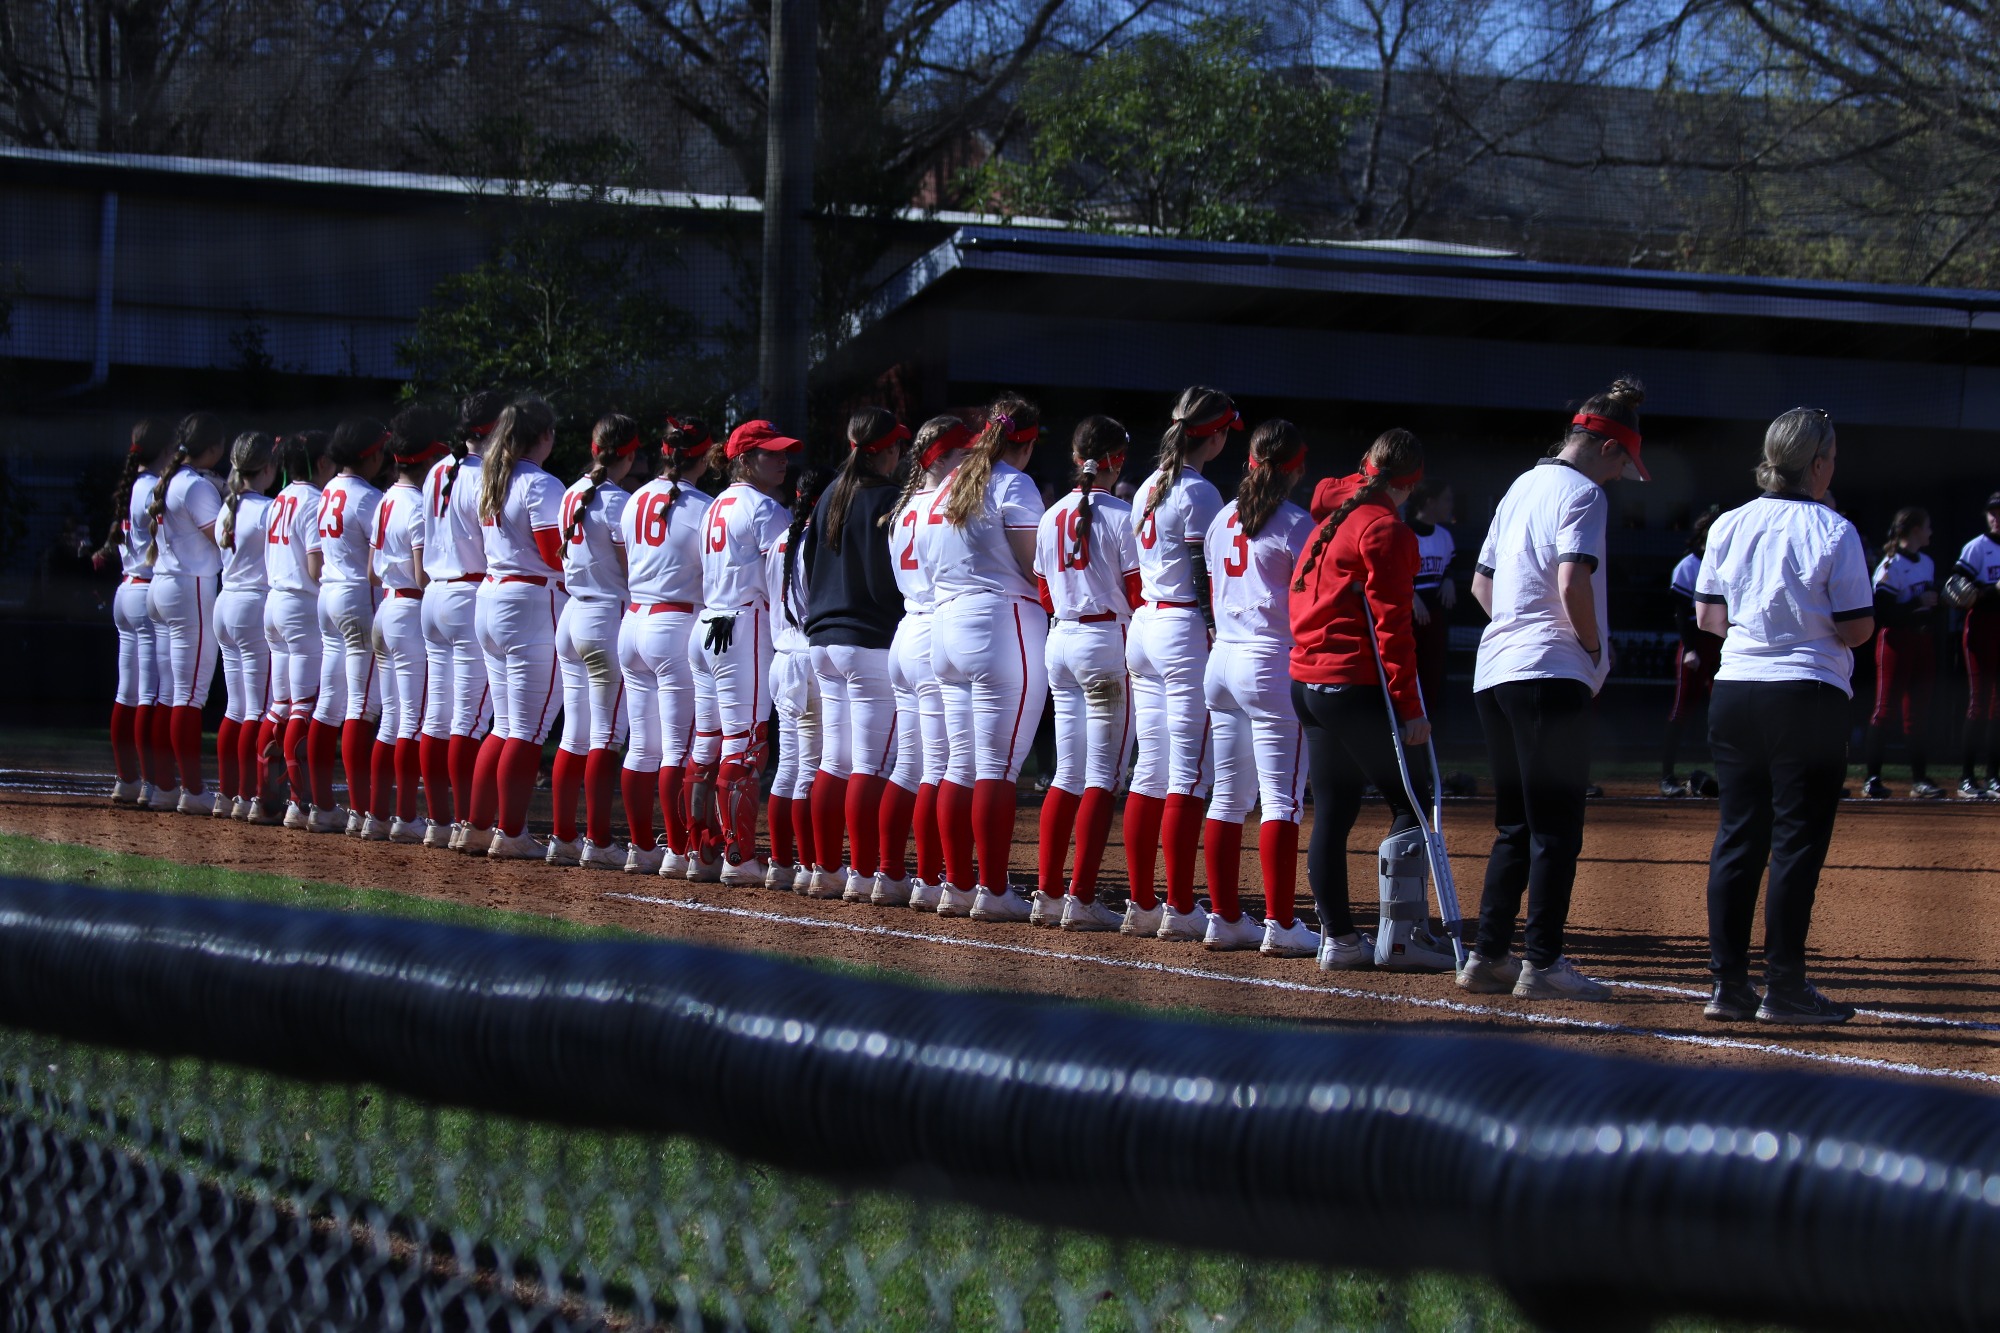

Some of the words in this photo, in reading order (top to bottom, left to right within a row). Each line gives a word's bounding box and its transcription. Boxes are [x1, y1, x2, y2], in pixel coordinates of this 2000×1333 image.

[268, 494, 298, 545] 20
[318, 488, 347, 538] 23
[635, 491, 670, 547] 16
[706, 497, 737, 554] 15
[900, 510, 918, 570] 2
[1055, 508, 1090, 572] 19
[1223, 511, 1250, 577] 3
